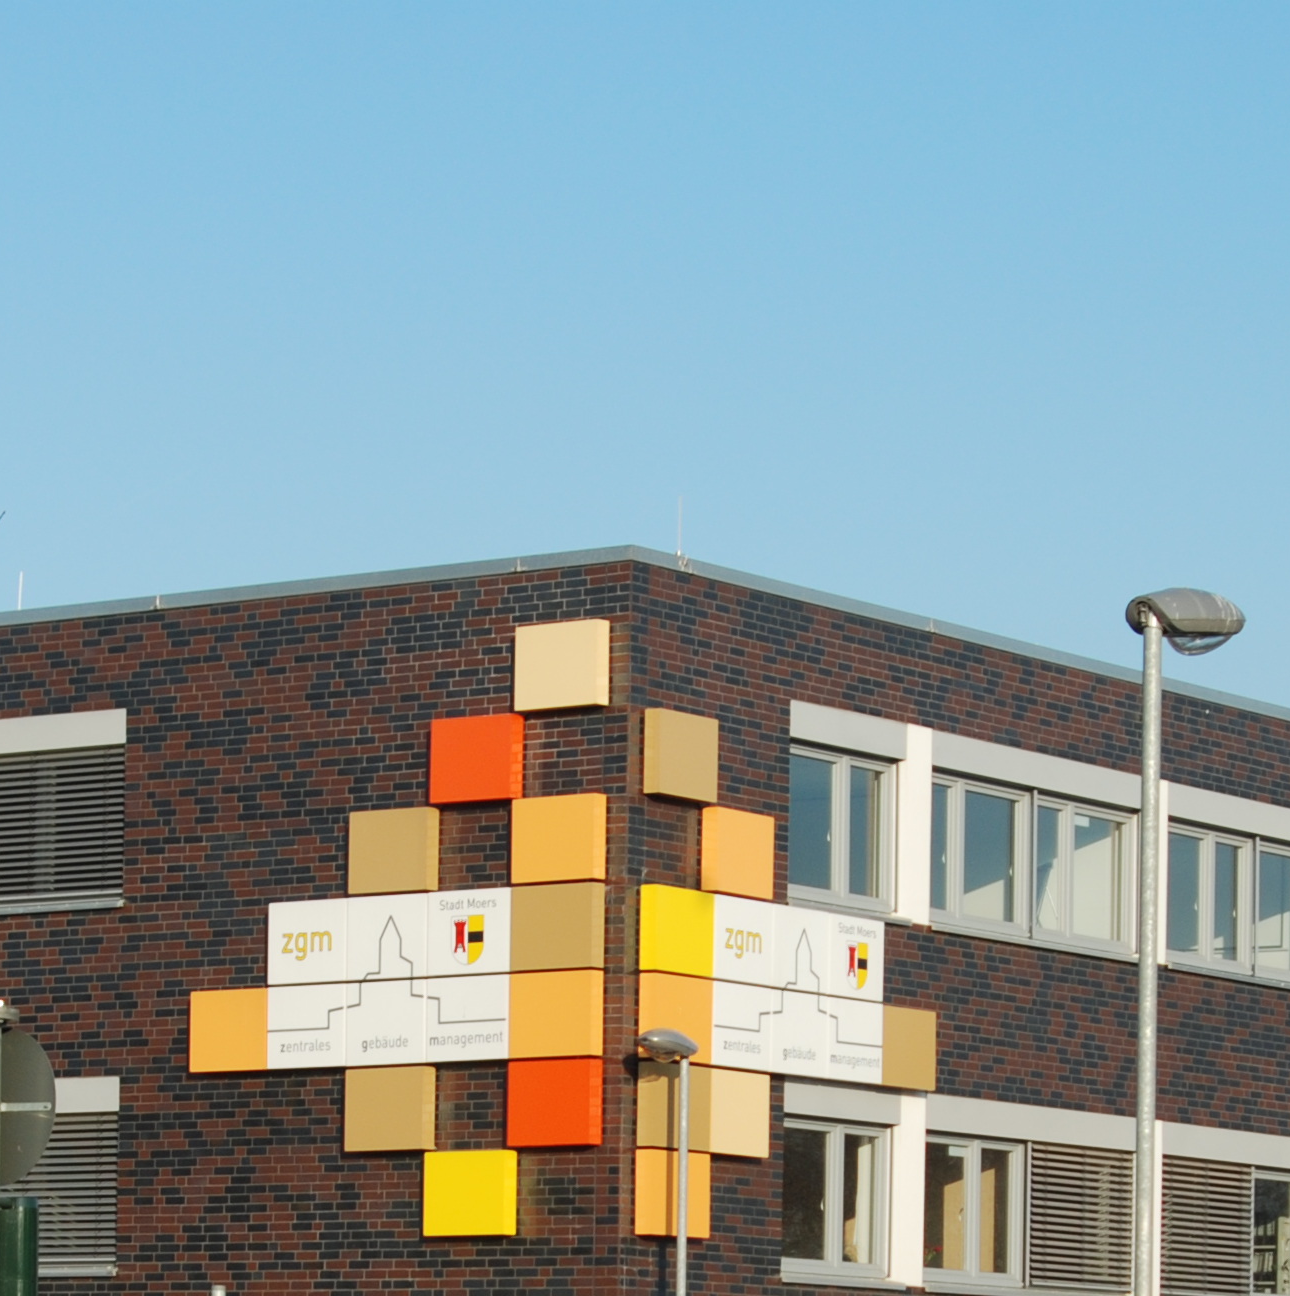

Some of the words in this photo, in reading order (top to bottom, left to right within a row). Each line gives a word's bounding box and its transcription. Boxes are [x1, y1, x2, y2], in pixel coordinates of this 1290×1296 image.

[439, 899, 464, 911] Stadt
[467, 898, 497, 909] Moers
[725, 927, 762, 959] zgm
[838, 922, 856, 935] Stadt
[857, 924, 877, 939] Moers
[281, 930, 333, 961] zgm
[280, 1038, 331, 1054] zentrales
[361, 1035, 409, 1053] gebäude
[429, 1031, 504, 1049] management
[723, 1040, 761, 1055] zentrales
[783, 1046, 816, 1061] gebäude
[830, 1053, 880, 1069] management
